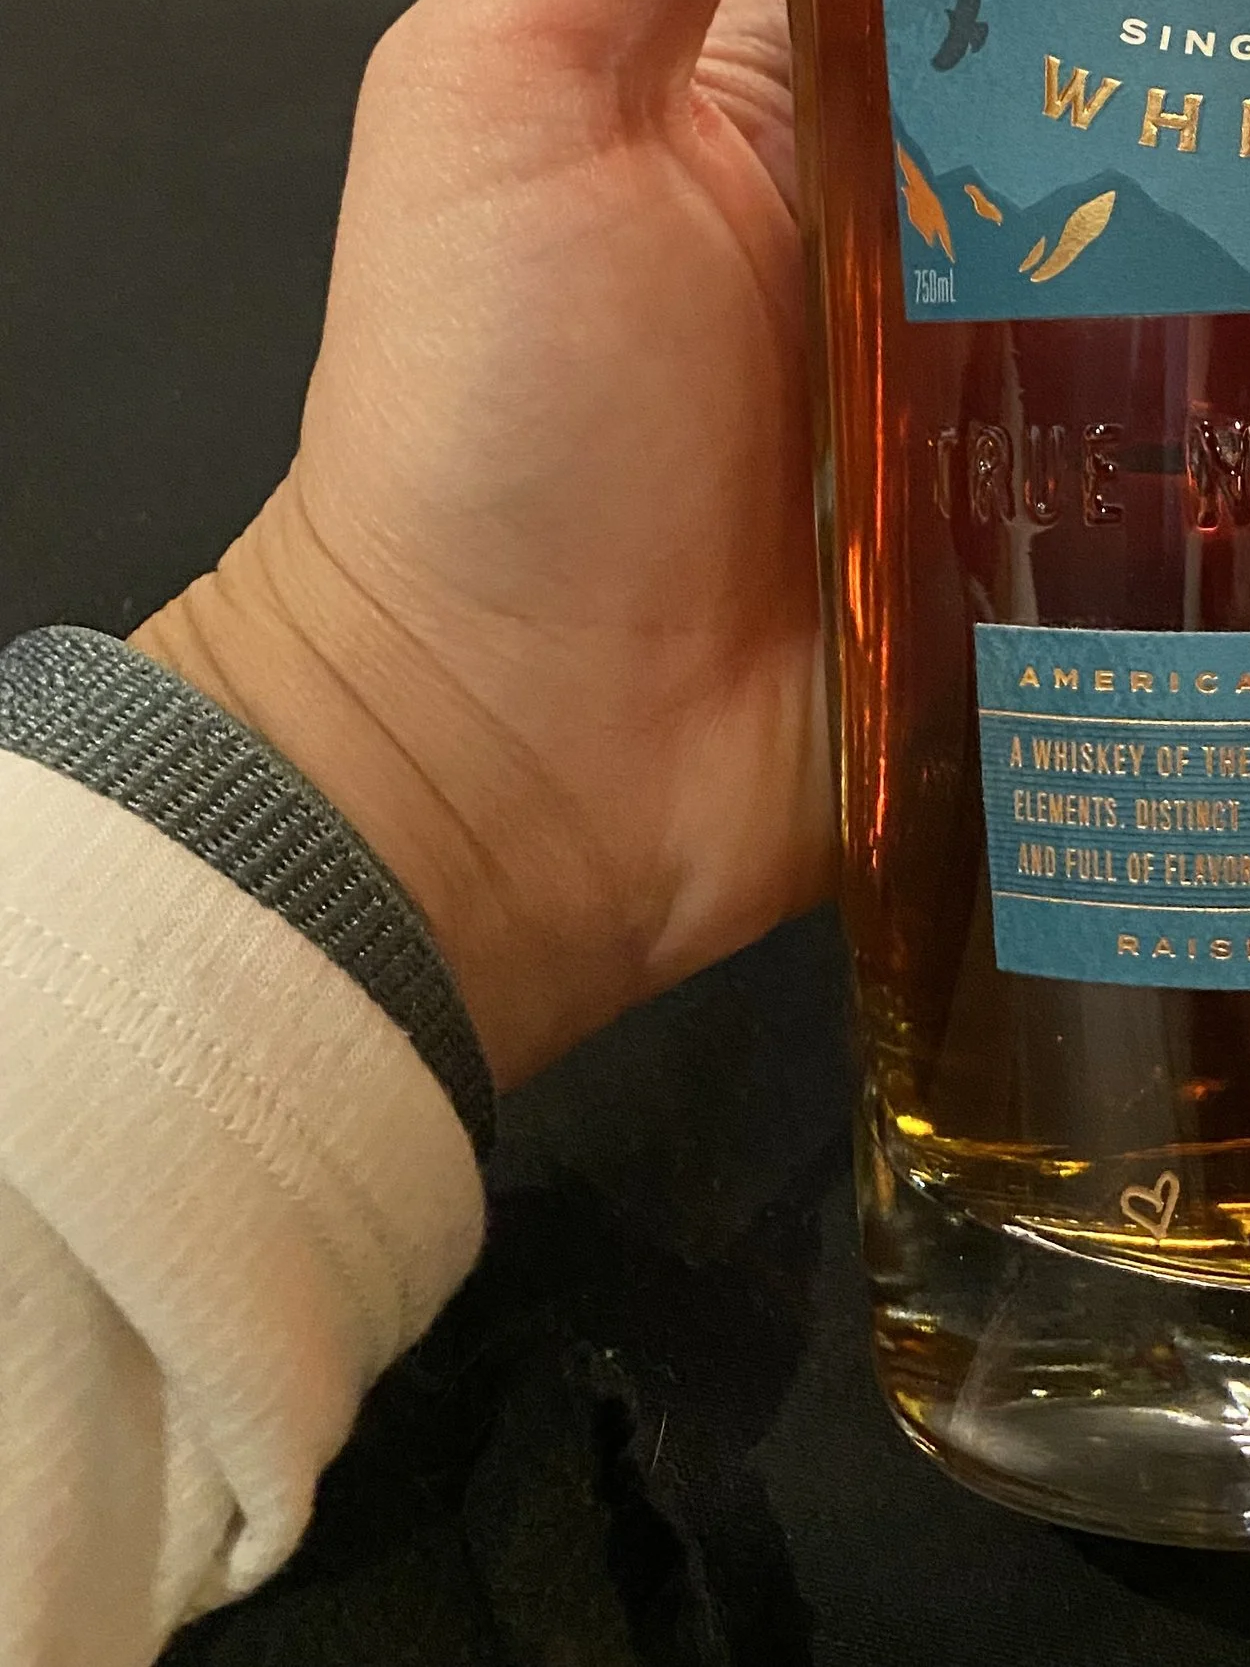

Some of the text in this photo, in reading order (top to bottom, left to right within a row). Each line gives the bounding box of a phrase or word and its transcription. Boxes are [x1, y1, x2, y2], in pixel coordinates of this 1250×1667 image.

[928, 422, 1126, 528] TRUE
[1009, 736, 1023, 768] A
[1031, 739, 1145, 777] WHISKEY
[1156, 745, 1190, 777] OF
[1135, 799, 1240, 832] DISTINCT
[1017, 842, 1056, 877] AND
[1065, 847, 1117, 883] FULL
[1126, 851, 1155, 885] OF
